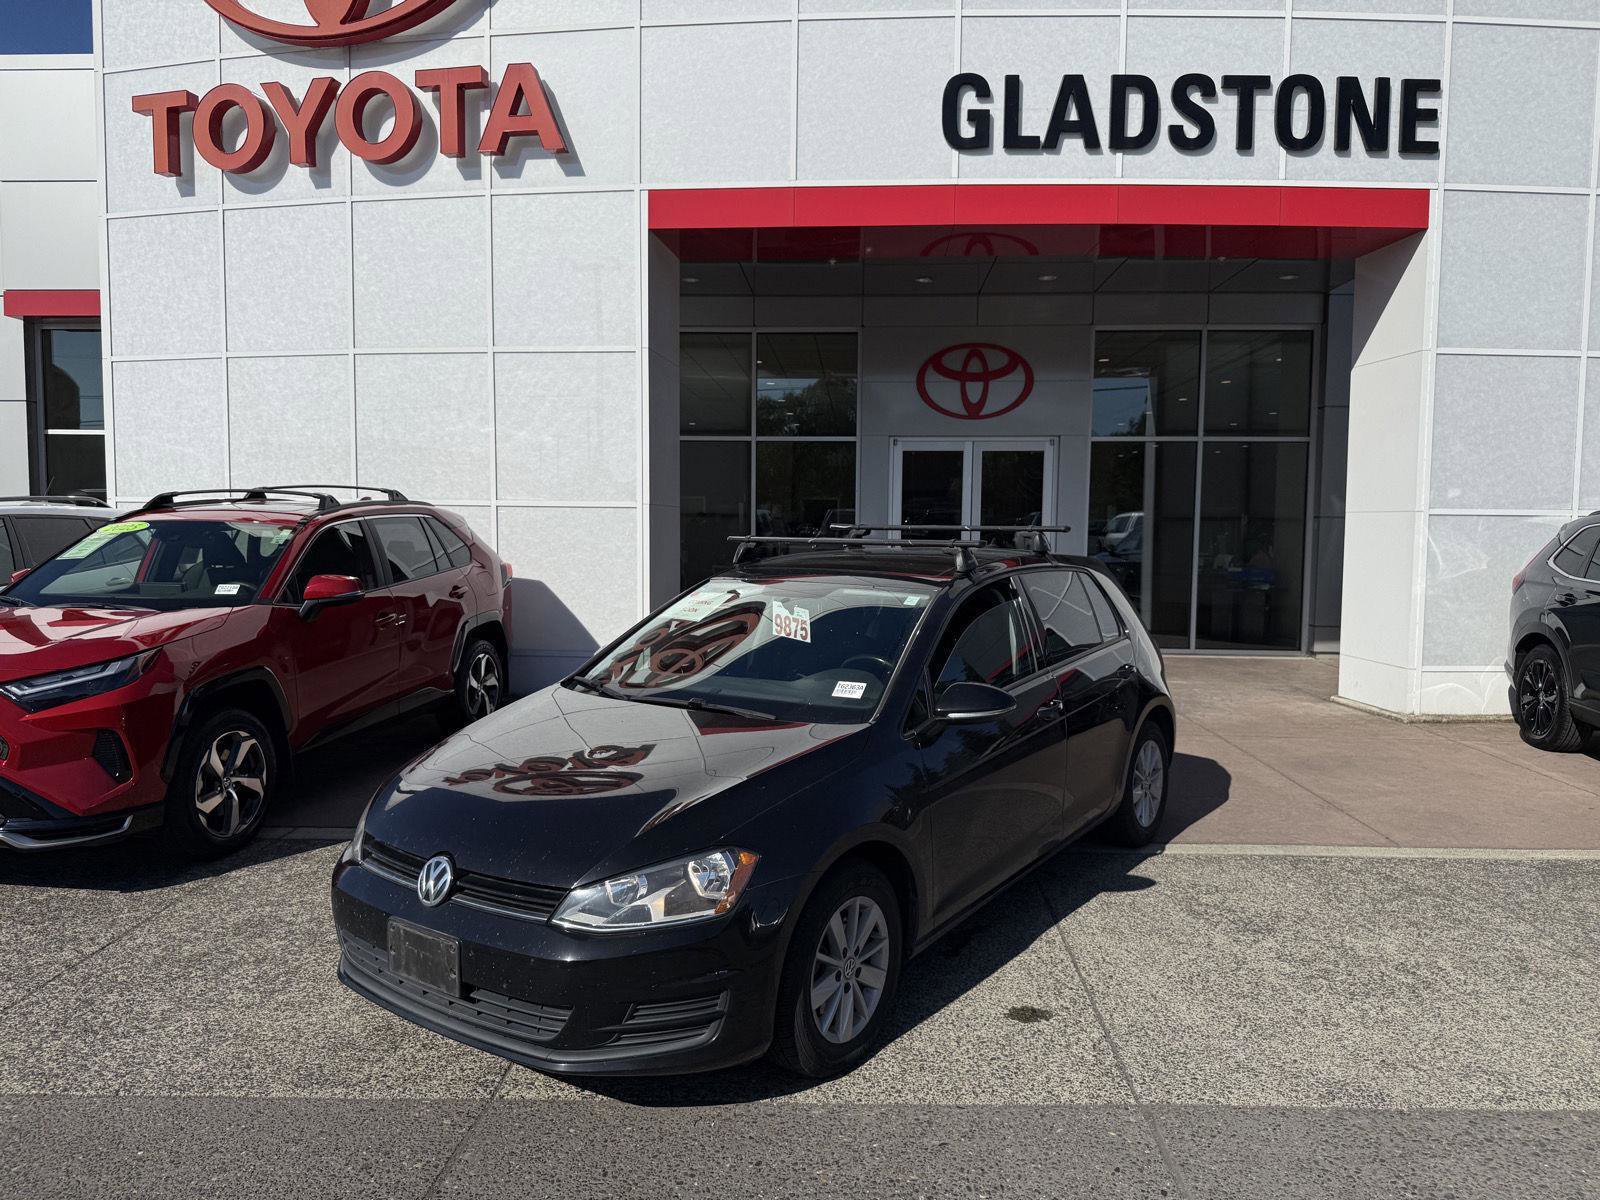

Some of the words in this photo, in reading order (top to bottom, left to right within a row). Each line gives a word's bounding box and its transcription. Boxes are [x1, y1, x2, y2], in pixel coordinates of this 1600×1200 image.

[132, 62, 568, 177] TOYOTA
[941, 73, 1442, 154] GLADSTONE
[774, 613, 809, 641] 9875
[418, 856, 452, 907] VW
